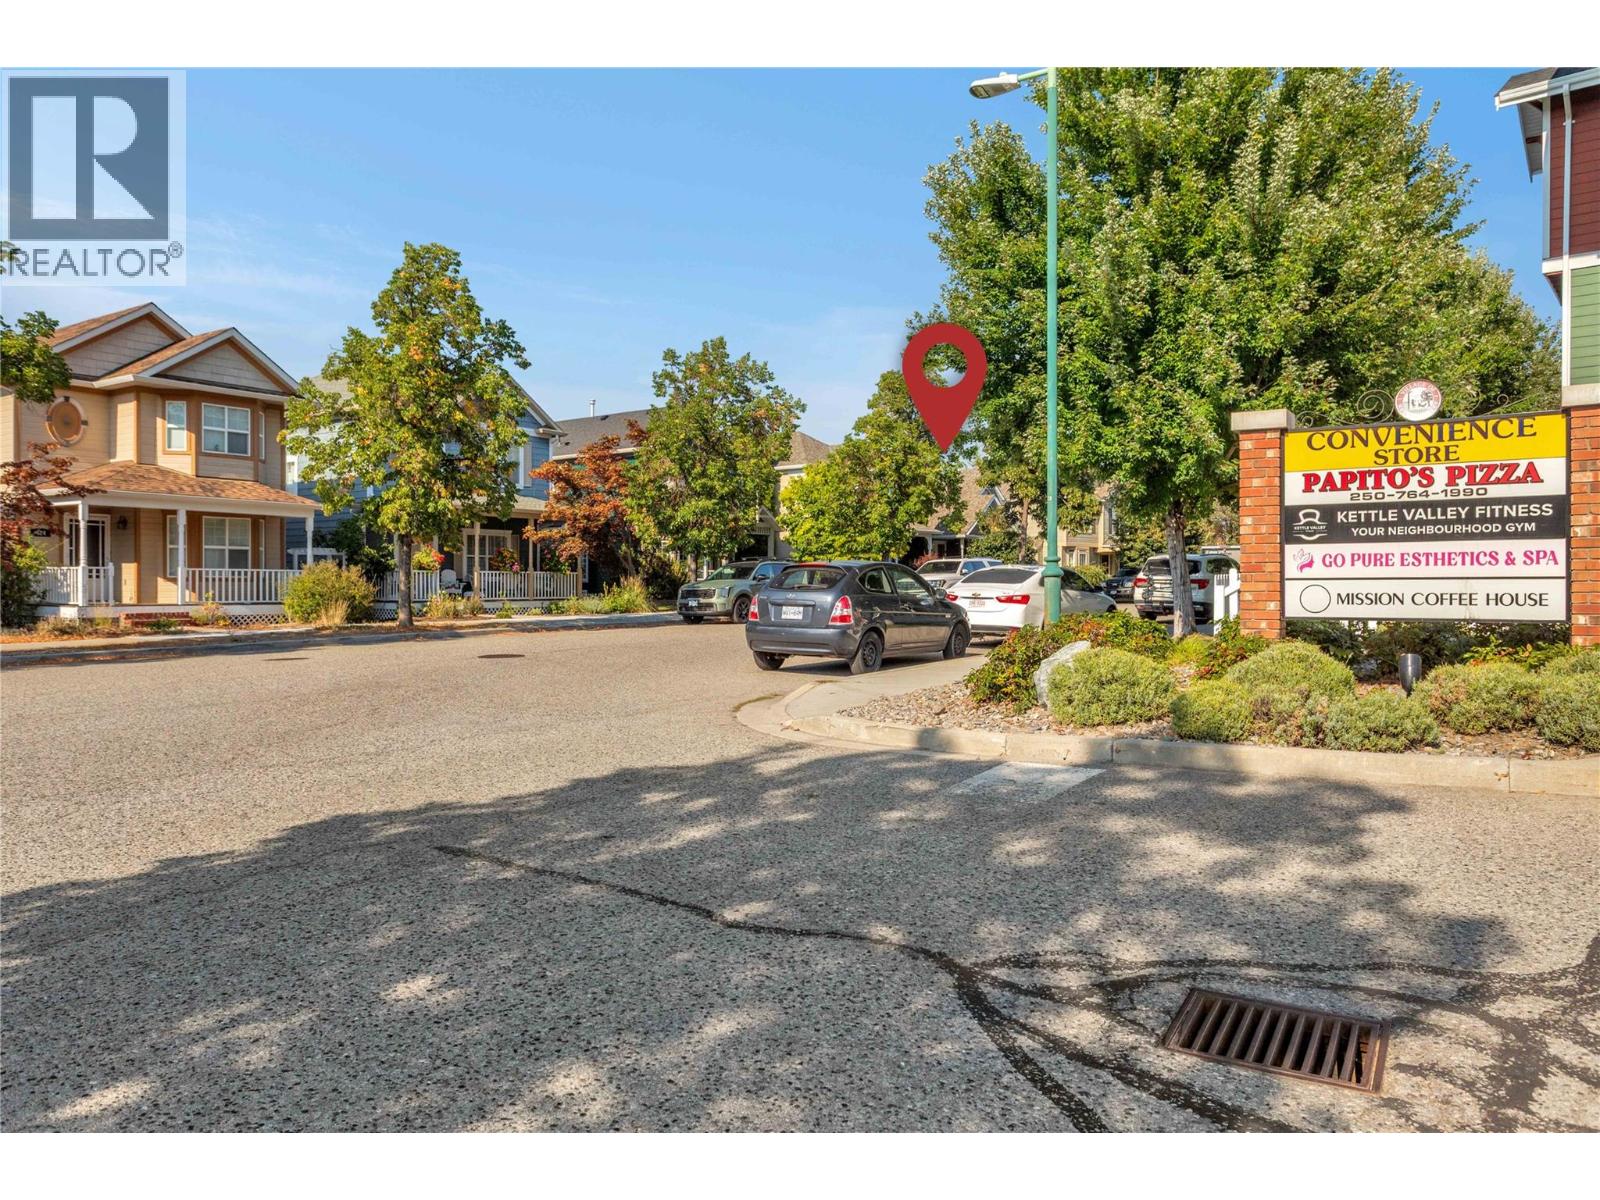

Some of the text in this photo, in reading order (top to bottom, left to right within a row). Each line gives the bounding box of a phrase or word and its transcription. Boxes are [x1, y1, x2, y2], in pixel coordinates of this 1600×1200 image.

[1306, 416, 1537, 451] CONVENIENCE
[1373, 444, 1460, 466] STORE
[1302, 461, 1544, 493] PAPITO'S PIZZA
[1350, 487, 1488, 501] 250-764-1990
[1337, 503, 1553, 523] KETTLE VALLEY FITNESS
[1351, 522, 1536, 537] YOUR NEIGHBOURHOOD GYM
[1321, 550, 1559, 568] GO PURE ESTHETICS & SPA
[1336, 592, 1549, 607] MISSION COFFEE HOUSE
